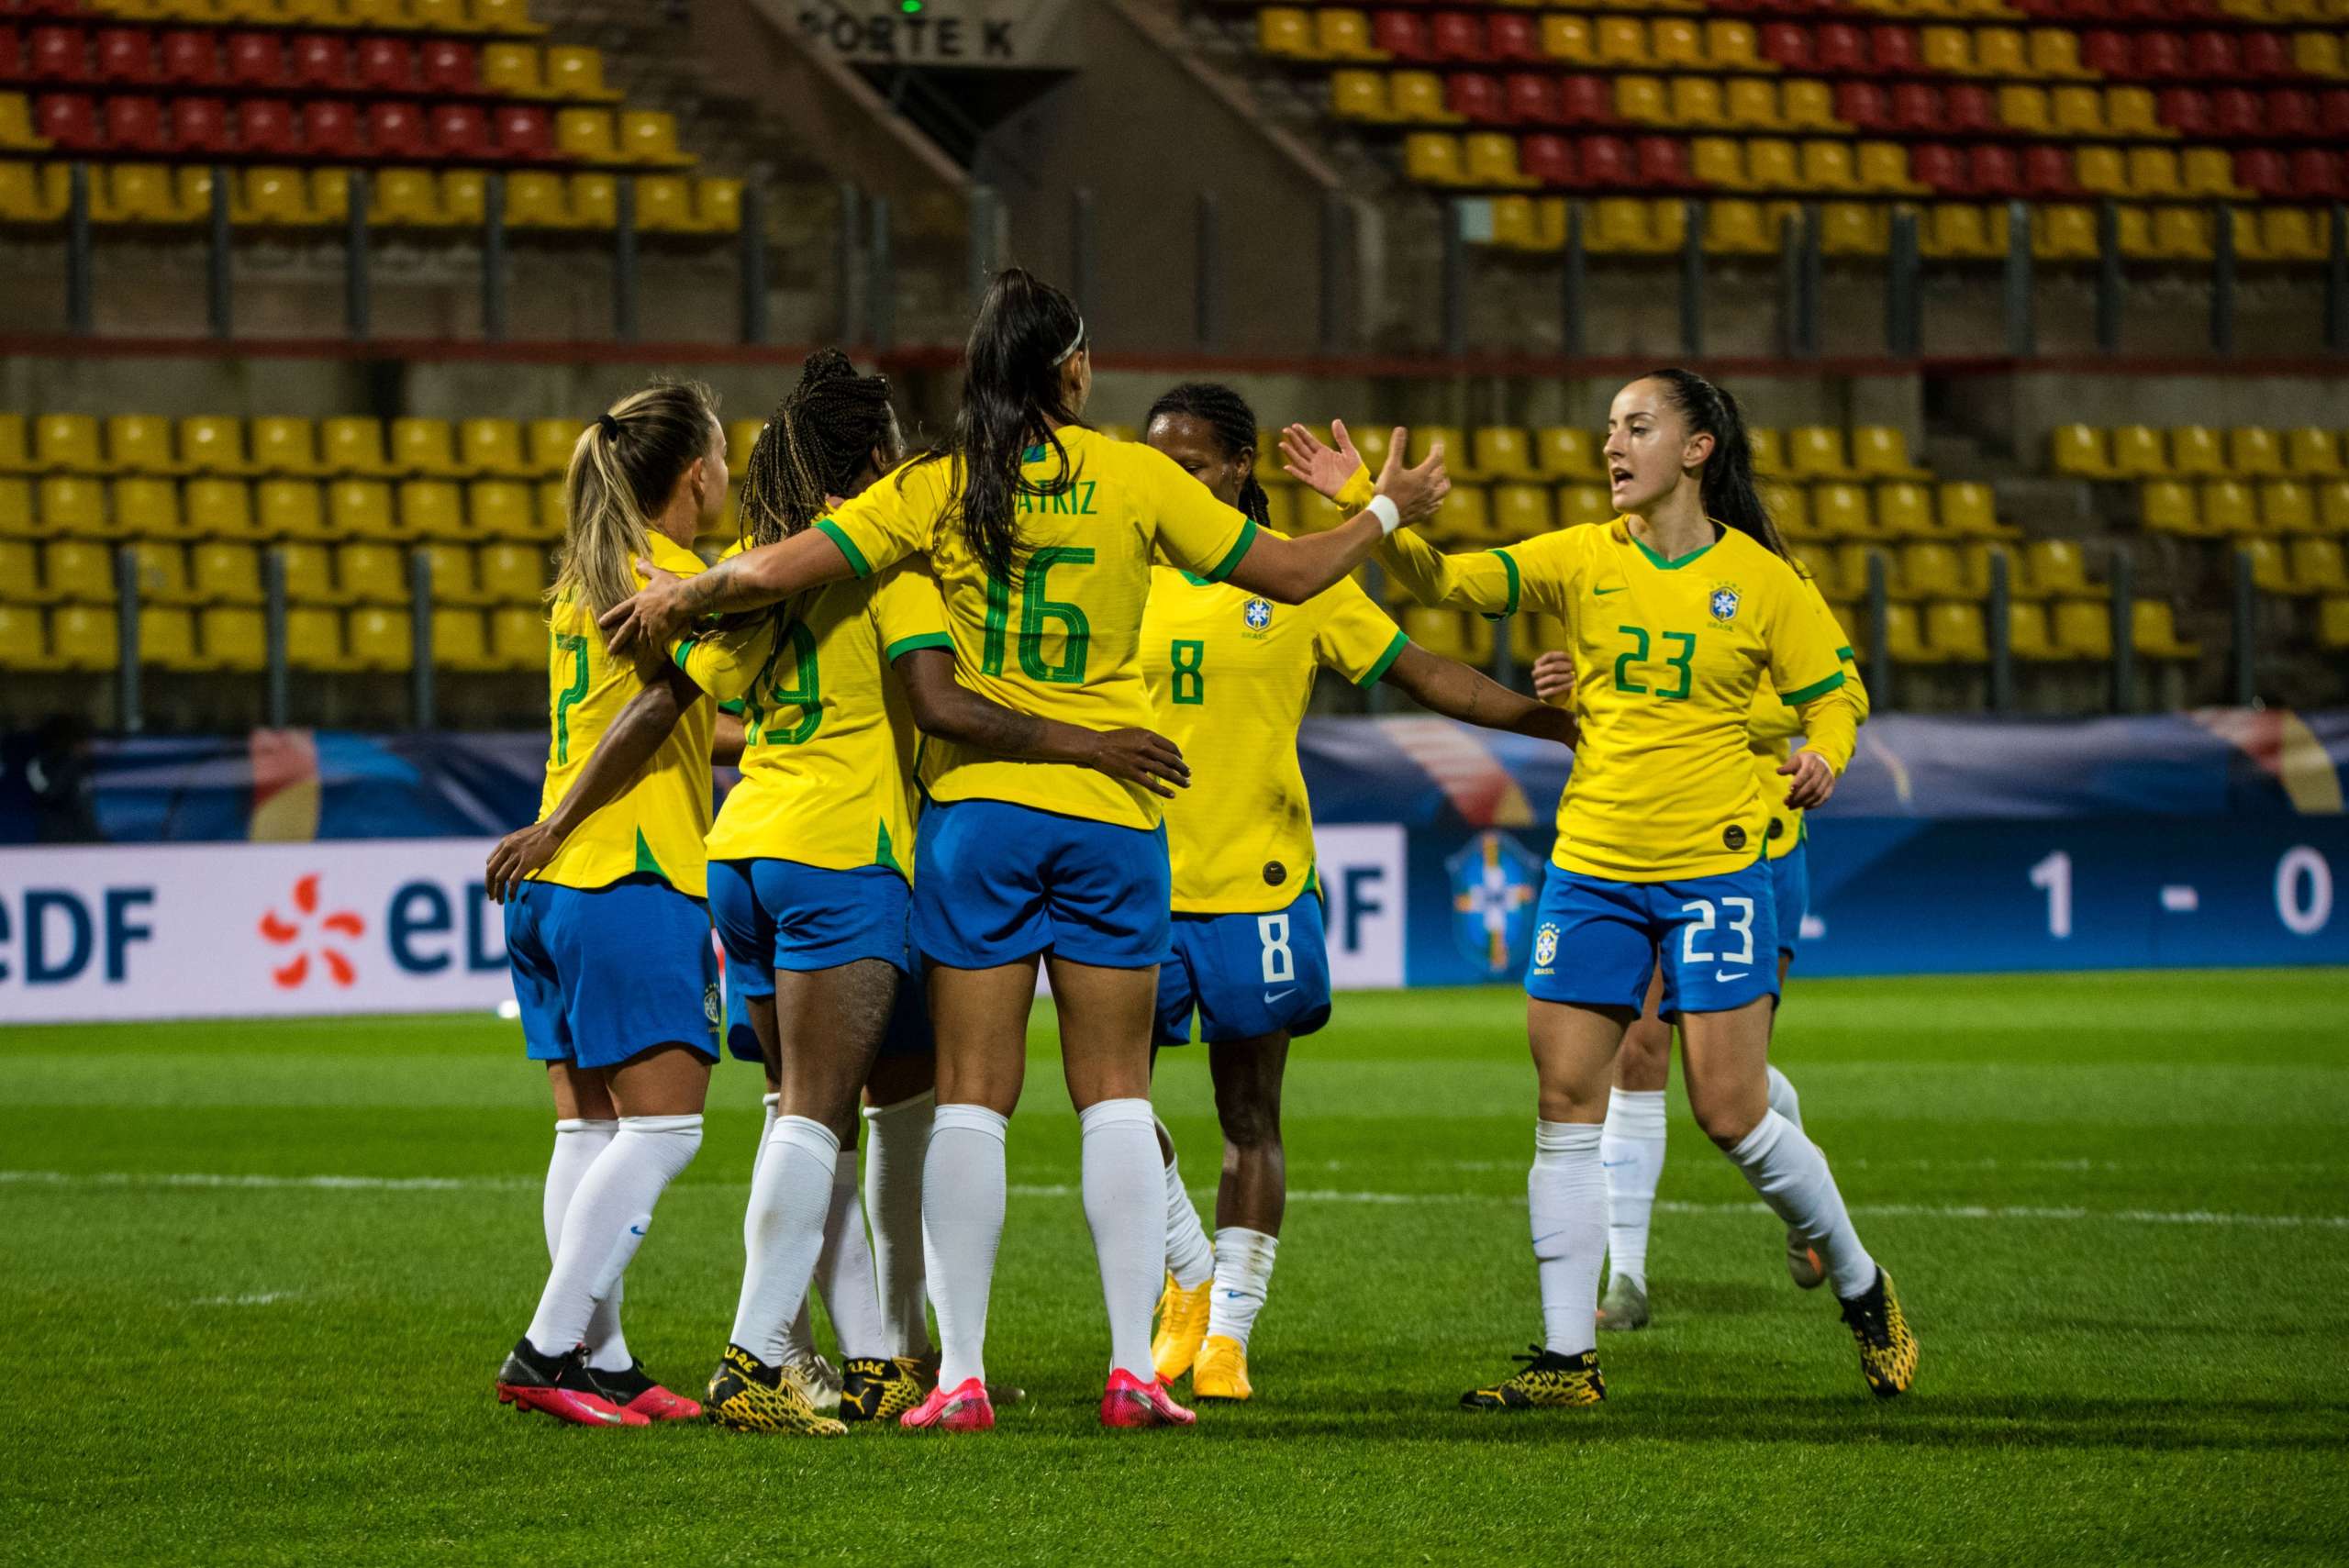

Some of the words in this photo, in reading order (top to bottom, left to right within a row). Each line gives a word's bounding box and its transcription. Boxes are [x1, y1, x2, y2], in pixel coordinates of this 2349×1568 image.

[983, 20, 1014, 57] K
[981, 547, 1096, 684] 16
[1171, 639, 1204, 705] 8
[1615, 626, 1696, 699] 23
[2030, 851, 2072, 939] 1
[2275, 845, 2333, 935] 0
[1258, 914, 1295, 983] 8
[1682, 896, 1754, 964] 23
